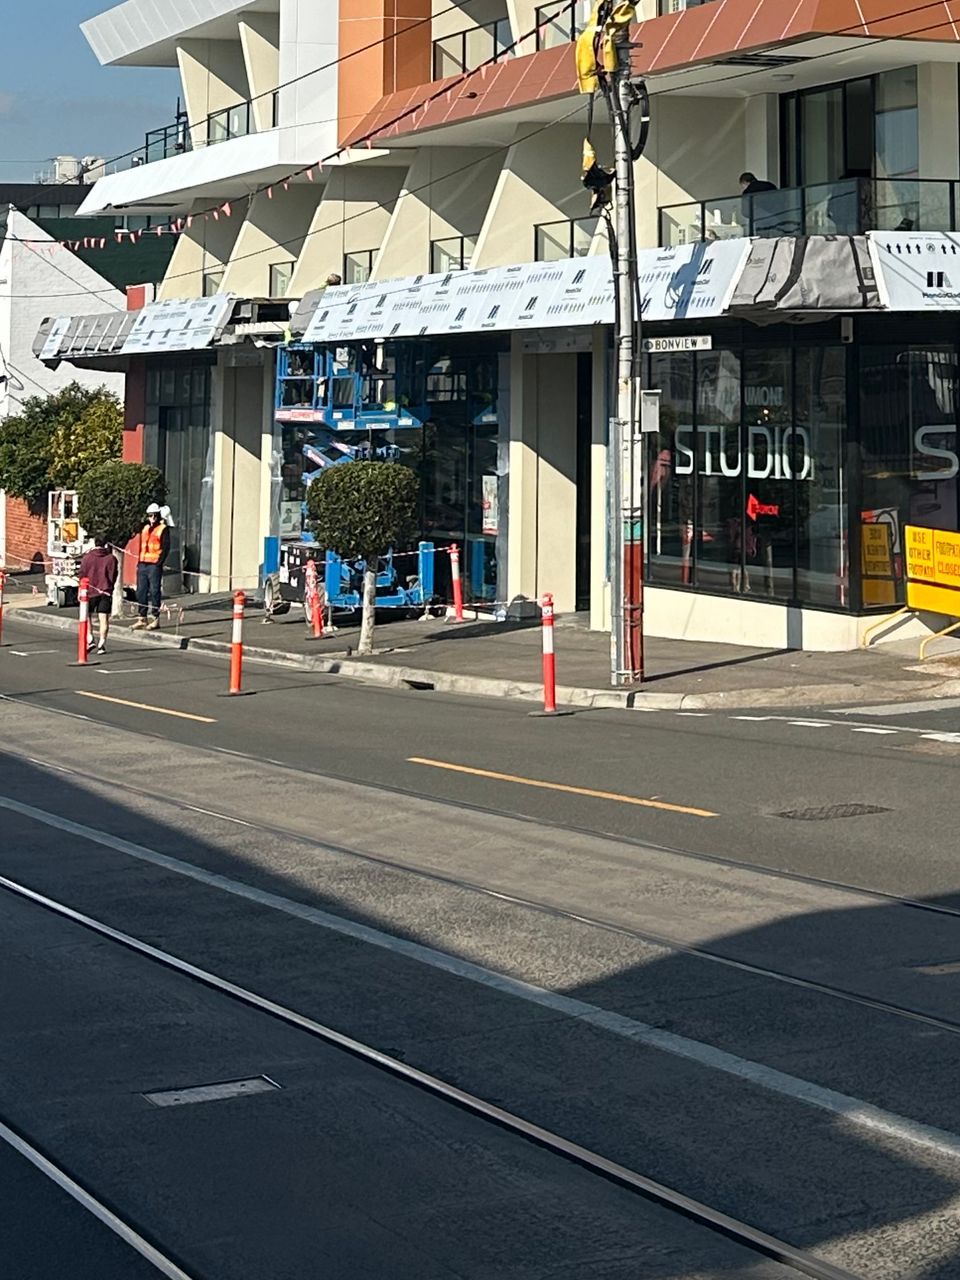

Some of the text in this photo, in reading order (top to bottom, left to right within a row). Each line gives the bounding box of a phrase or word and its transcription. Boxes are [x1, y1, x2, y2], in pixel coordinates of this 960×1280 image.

[655, 338, 698, 350] BONVIEW
[675, 424, 811, 480] STUDIO
[912, 531, 926, 544] USE
[908, 547, 931, 561] OTHER
